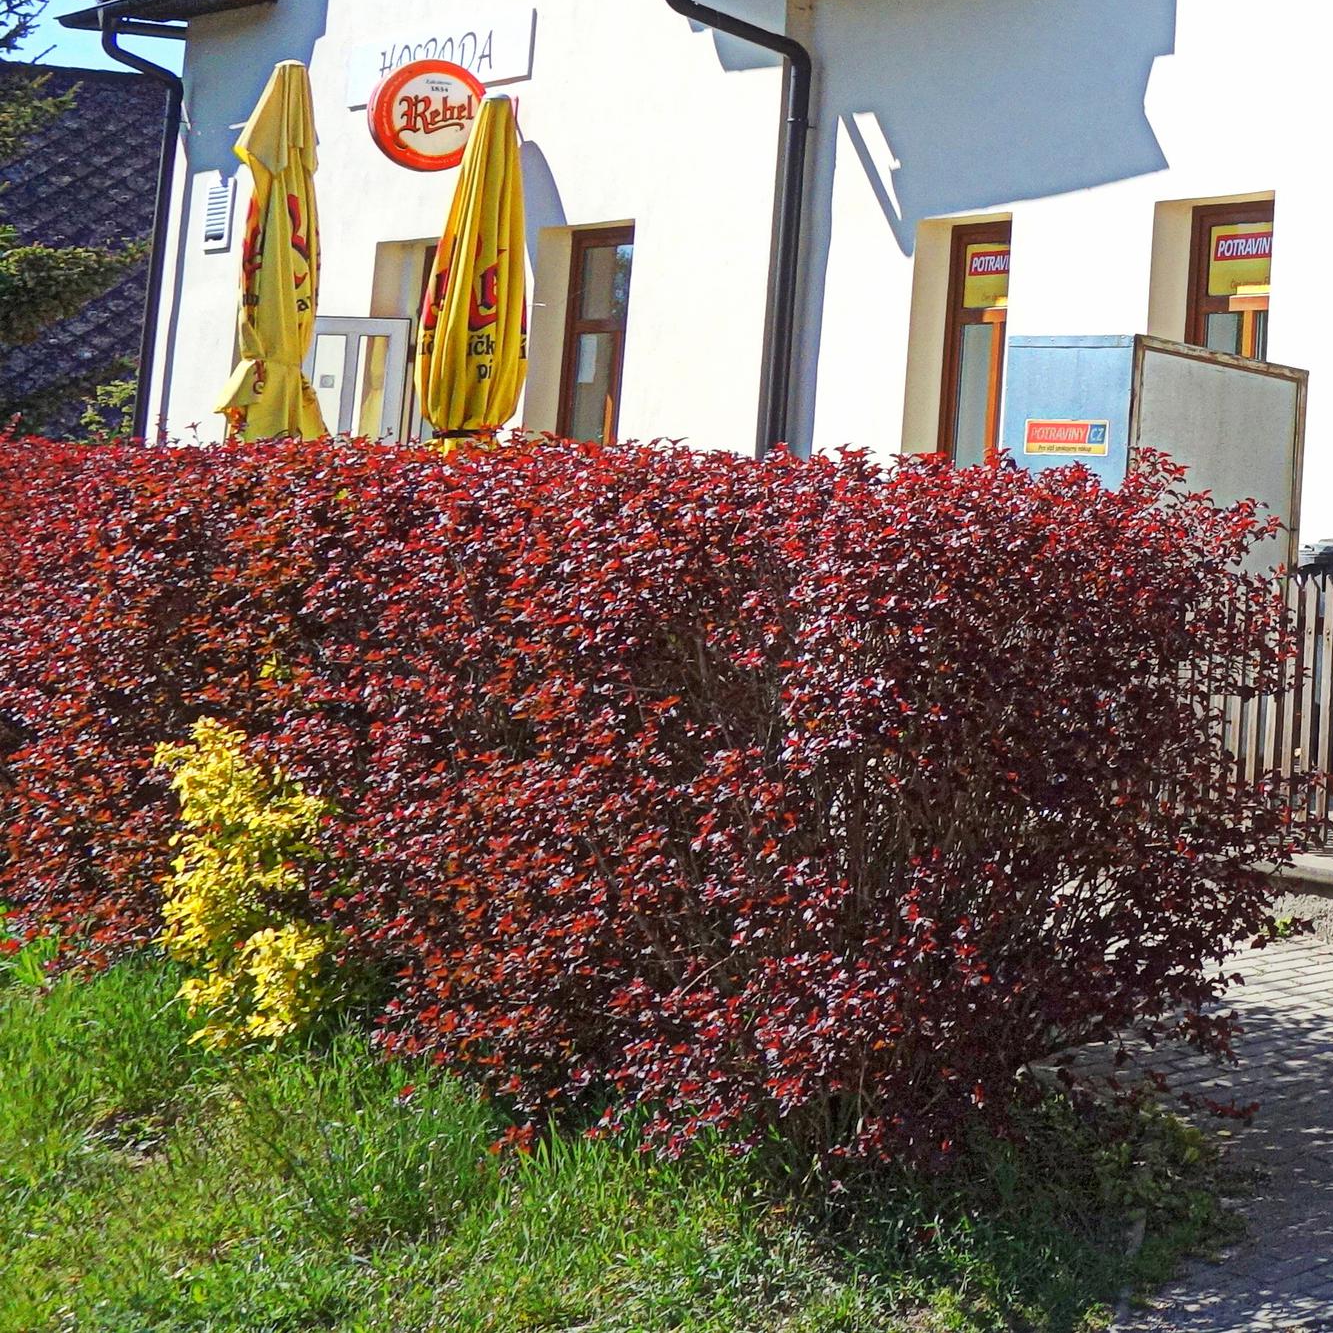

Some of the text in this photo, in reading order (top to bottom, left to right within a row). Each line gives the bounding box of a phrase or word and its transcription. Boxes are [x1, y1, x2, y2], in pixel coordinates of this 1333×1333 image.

[397, 93, 475, 135] Rebel
[1030, 426, 1105, 442] POTRAVINY CZ
